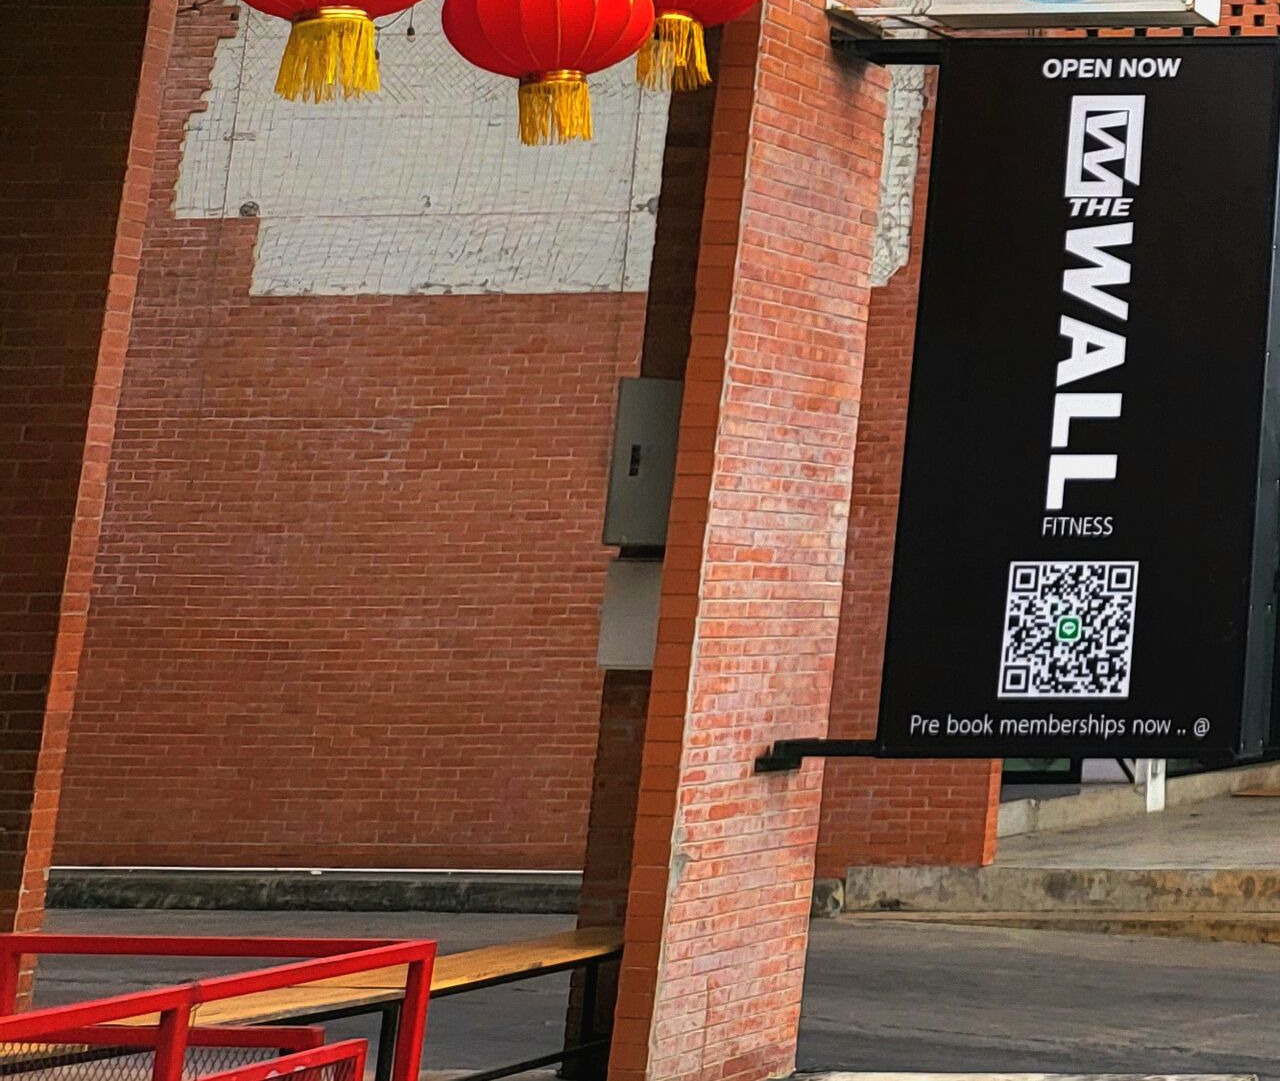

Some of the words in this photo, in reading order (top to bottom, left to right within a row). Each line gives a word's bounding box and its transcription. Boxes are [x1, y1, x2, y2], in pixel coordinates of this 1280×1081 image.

[1042, 59, 1113, 79] OPEN
[1119, 58, 1182, 77] NOW
[1068, 197, 1134, 217] THE
[1045, 222, 1134, 511] WALL
[1042, 516, 1114, 536] FITNESS
[909, 714, 941, 735] Pre
[946, 714, 994, 736] book
[998, 714, 1126, 740] memberships
[1131, 718, 1172, 736] now
